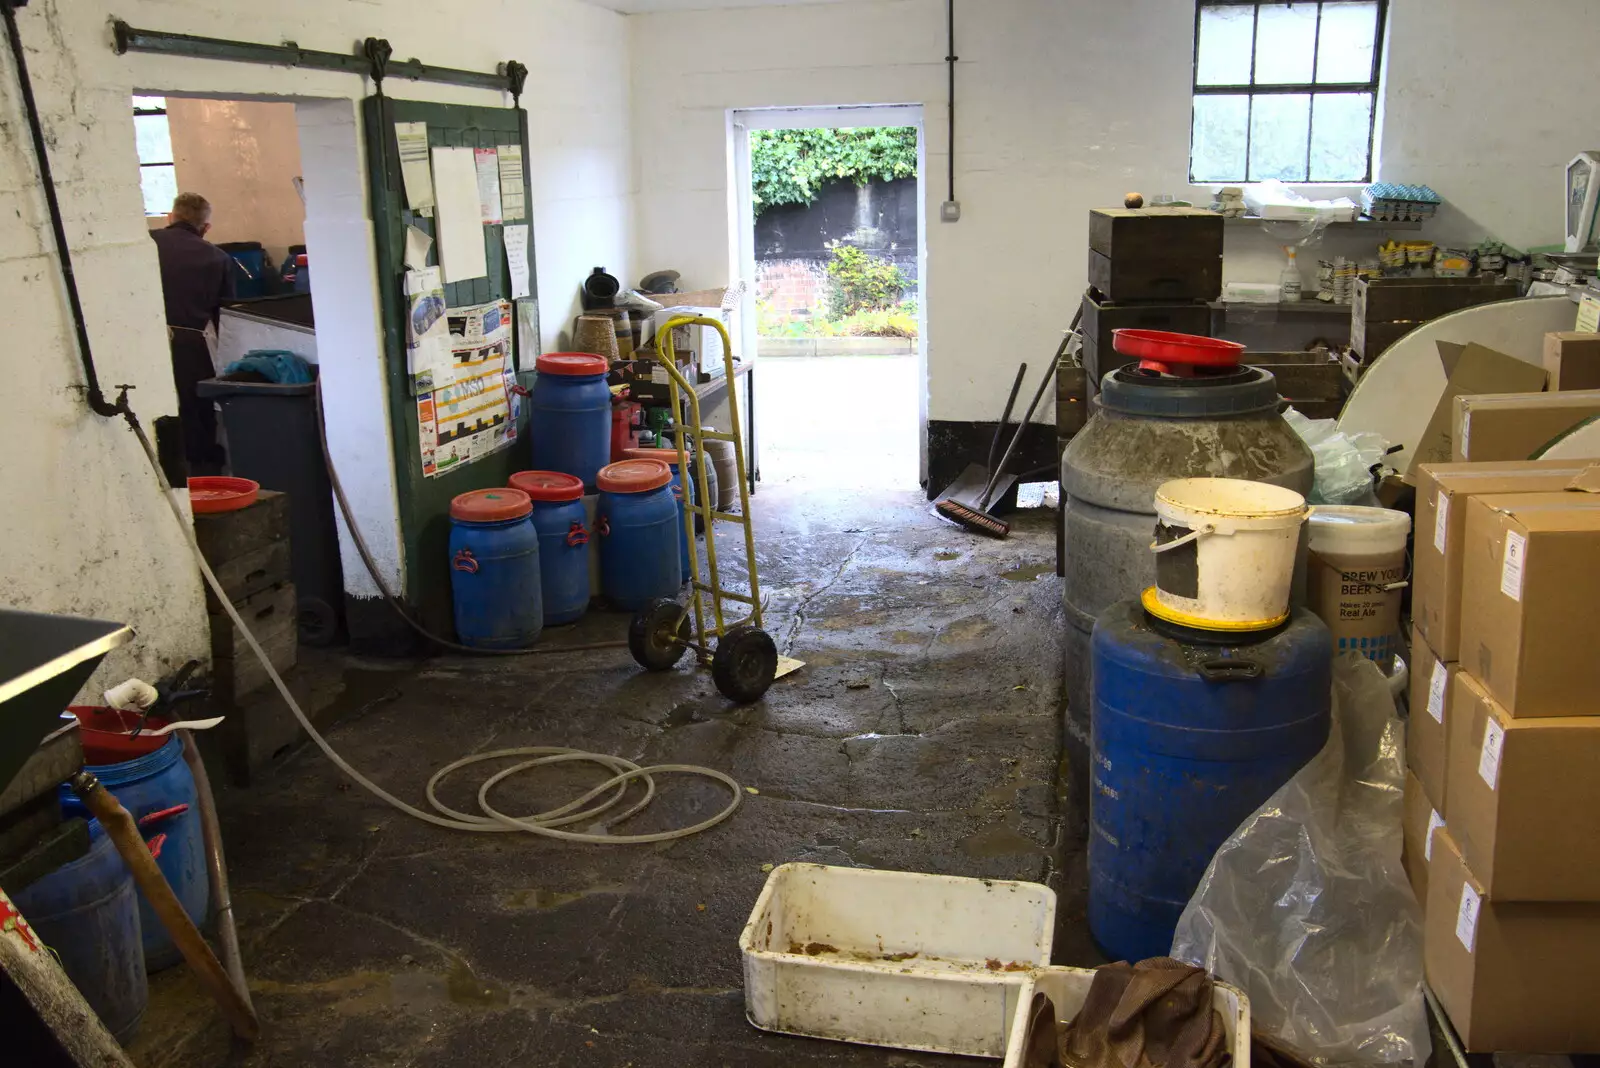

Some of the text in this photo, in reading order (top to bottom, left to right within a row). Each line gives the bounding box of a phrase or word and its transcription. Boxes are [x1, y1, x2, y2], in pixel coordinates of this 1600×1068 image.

[1342, 571, 1377, 581] BREW
[1341, 584, 1372, 595] BEER
[1340, 609, 1376, 617] Real Ale
